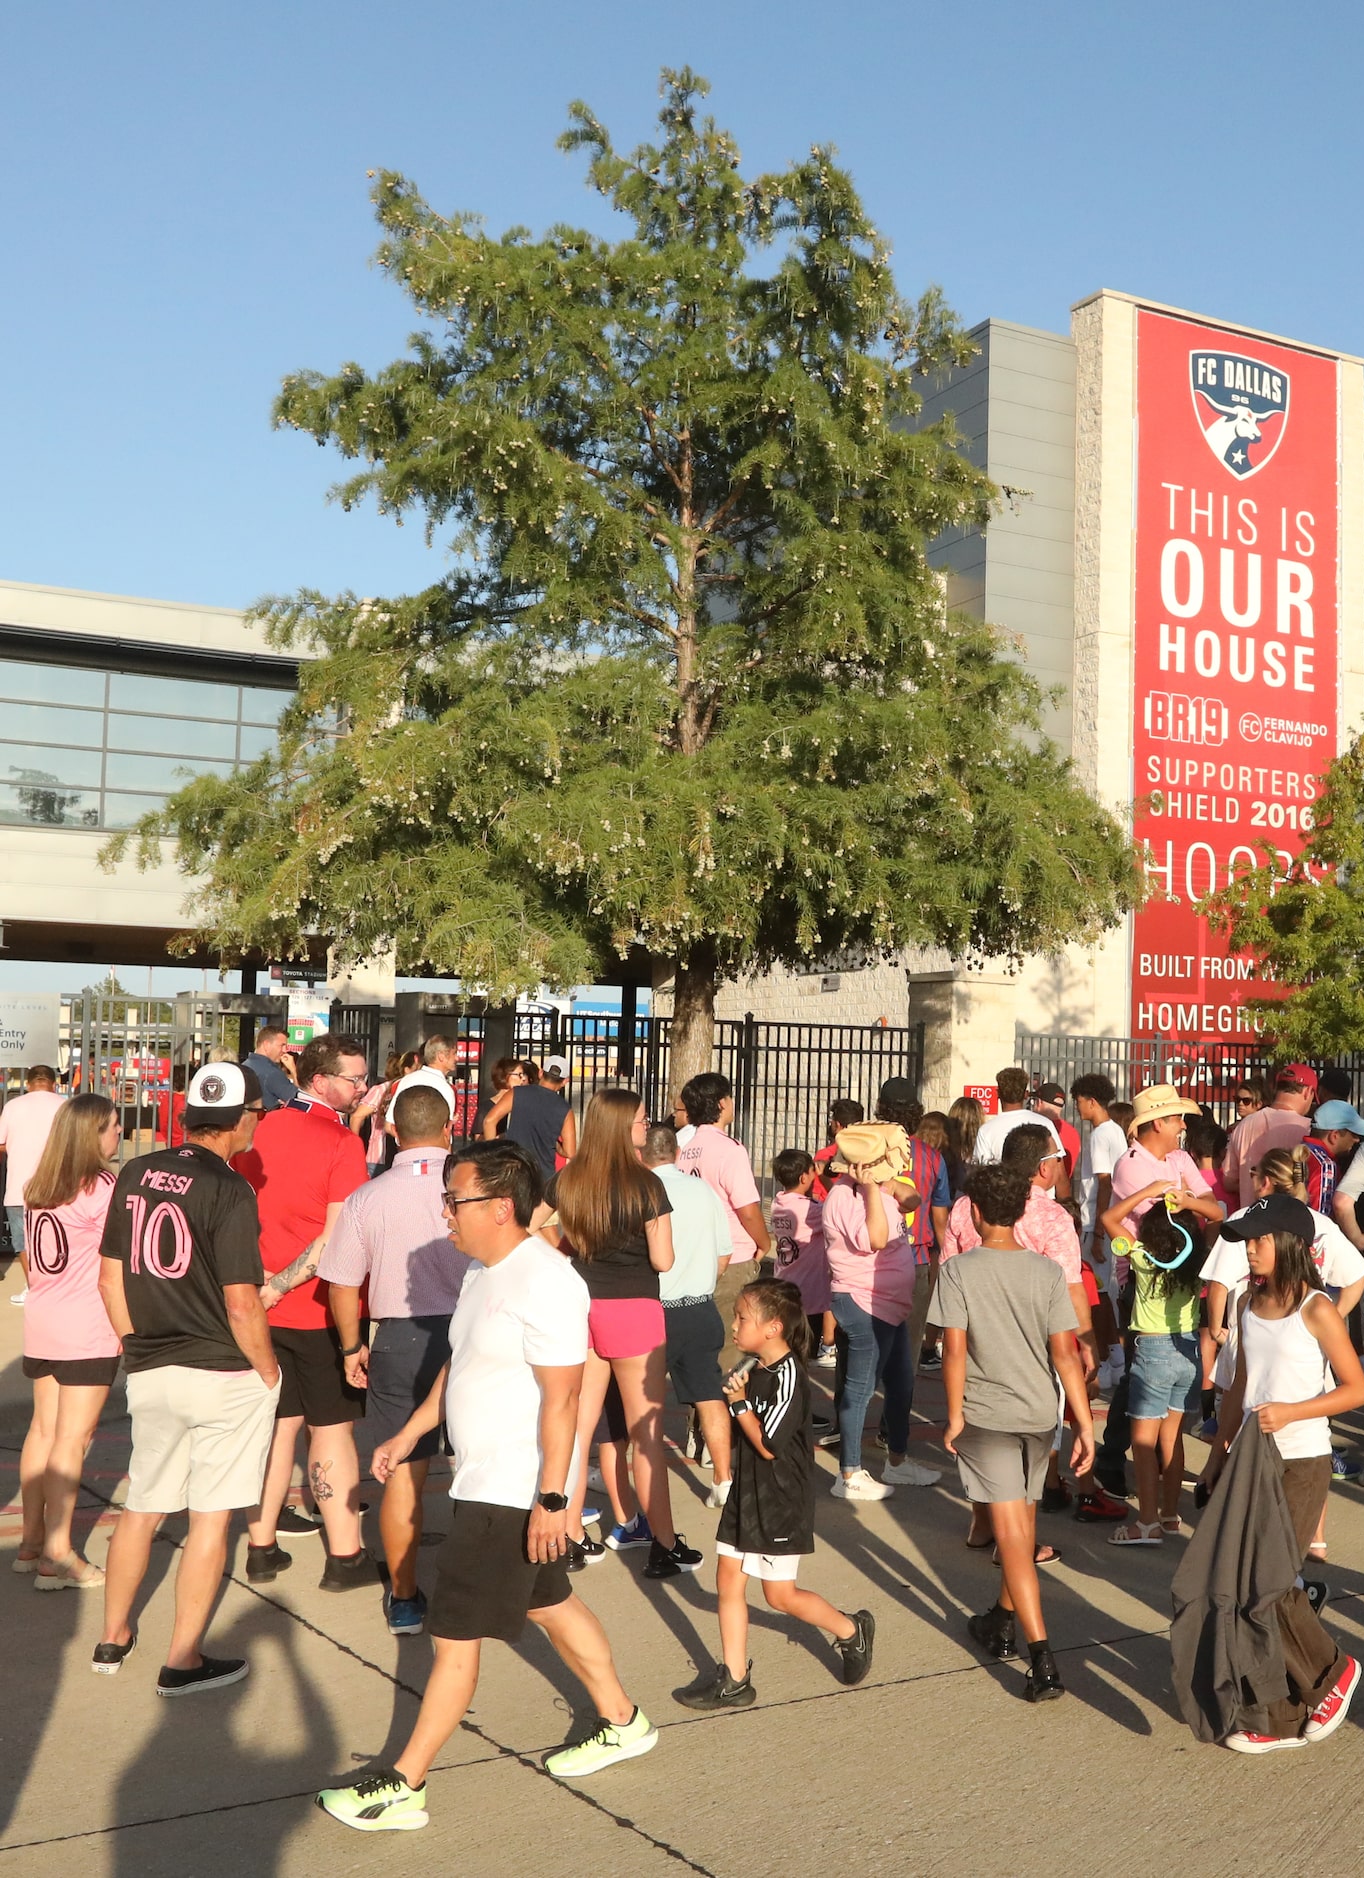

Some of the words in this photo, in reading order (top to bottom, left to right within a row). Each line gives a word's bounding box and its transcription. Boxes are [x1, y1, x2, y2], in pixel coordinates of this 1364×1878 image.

[1197, 357, 1217, 386] FC
[1223, 359, 1282, 404] DALLAS
[1231, 393, 1250, 405] 96
[1160, 482, 1259, 546] THIS
[1280, 506, 1316, 558] IS
[1159, 537, 1315, 639] OUR
[1158, 623, 1316, 693] HOUSE
[1144, 690, 1229, 747] BR19
[1263, 716, 1328, 737] FERNANDO
[1263, 730, 1313, 748] CLAVIJO
[1150, 788, 1240, 824] SHIELD
[1250, 800, 1316, 831] 2016
[1139, 953, 1195, 978] BUILT
[1200, 956, 1254, 981] FROM
[0, 1028, 26, 1040] Entry
[1, 1039, 25, 1051] Only
[970, 1087, 993, 1099] FDC
[680, 1147, 703, 1161] MESSI
[139, 1168, 194, 1196] MESSI
[126, 1194, 193, 1280] 10
